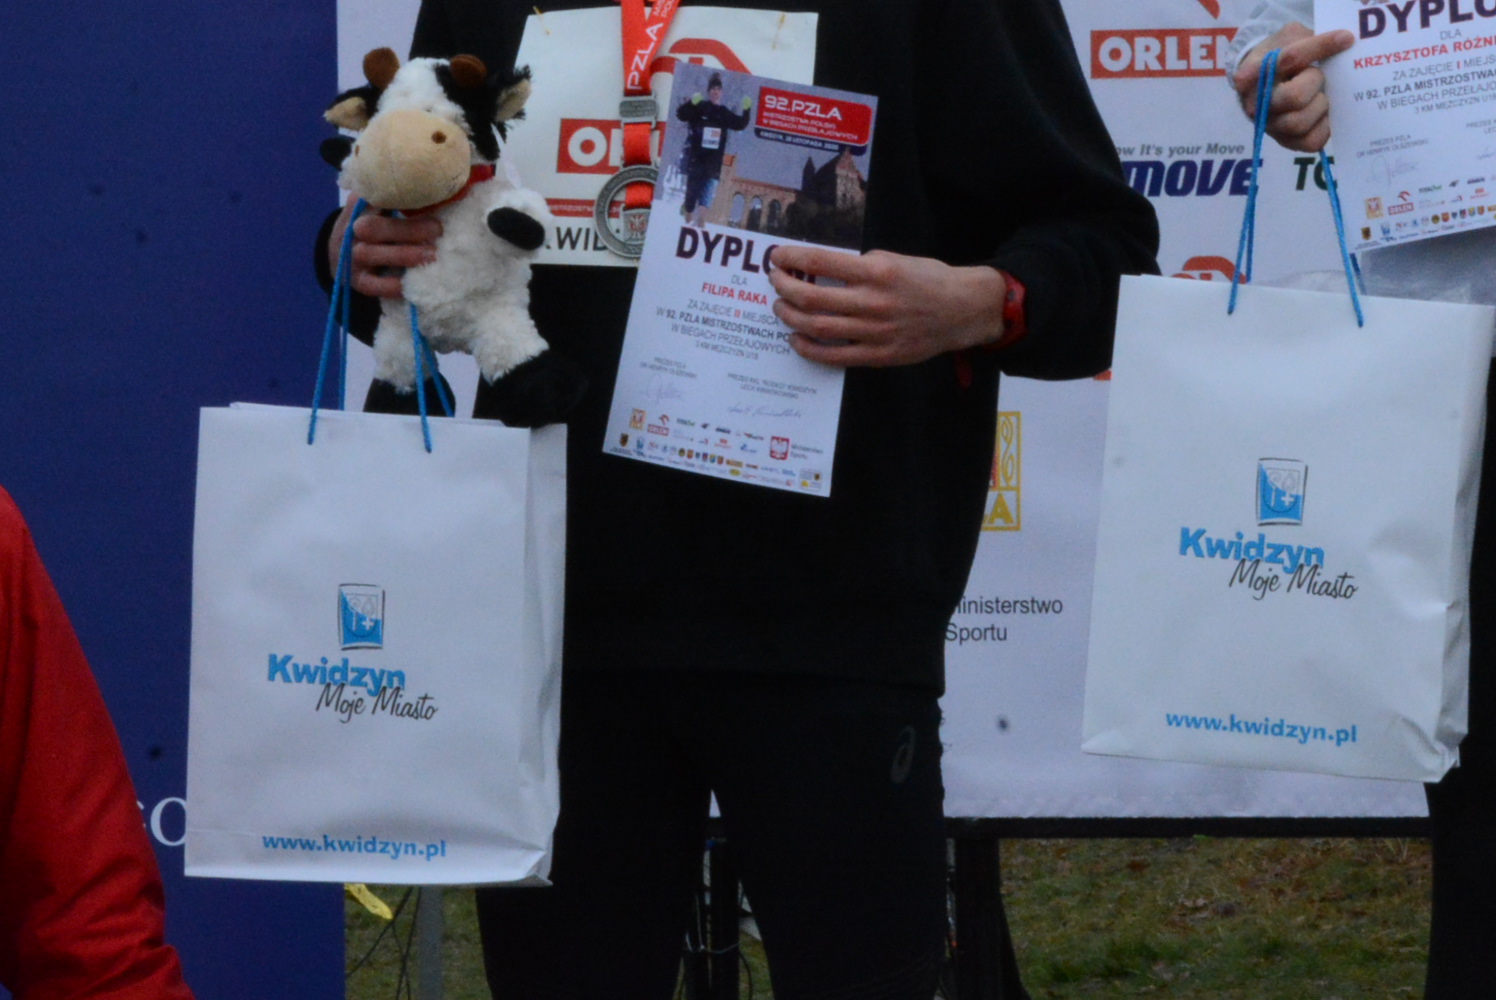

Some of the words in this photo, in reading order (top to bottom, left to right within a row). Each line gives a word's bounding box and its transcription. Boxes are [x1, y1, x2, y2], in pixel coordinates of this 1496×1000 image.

[626, 22, 664, 90] PZLA
[1353, 44, 1449, 70] KRZYSZTOFA
[1383, 84, 1413, 97] PZLA
[764, 94, 843, 121] 92.PZLA
[1205, 143, 1245, 156] Move
[701, 282, 735, 299] FILIPA
[737, 288, 769, 306] RAKA
[1178, 526, 1326, 575] Kwidzyn
[1228, 557, 1282, 601] Moje
[1286, 562, 1360, 601] Miasto
[267, 652, 406, 697] Kwidzyn
[315, 681, 366, 724] Moje
[371, 684, 440, 723] Miasto
[1165, 710, 1358, 748] www.kwidzyn.pl
[261, 833, 448, 859] www.kwidzyn.pl
